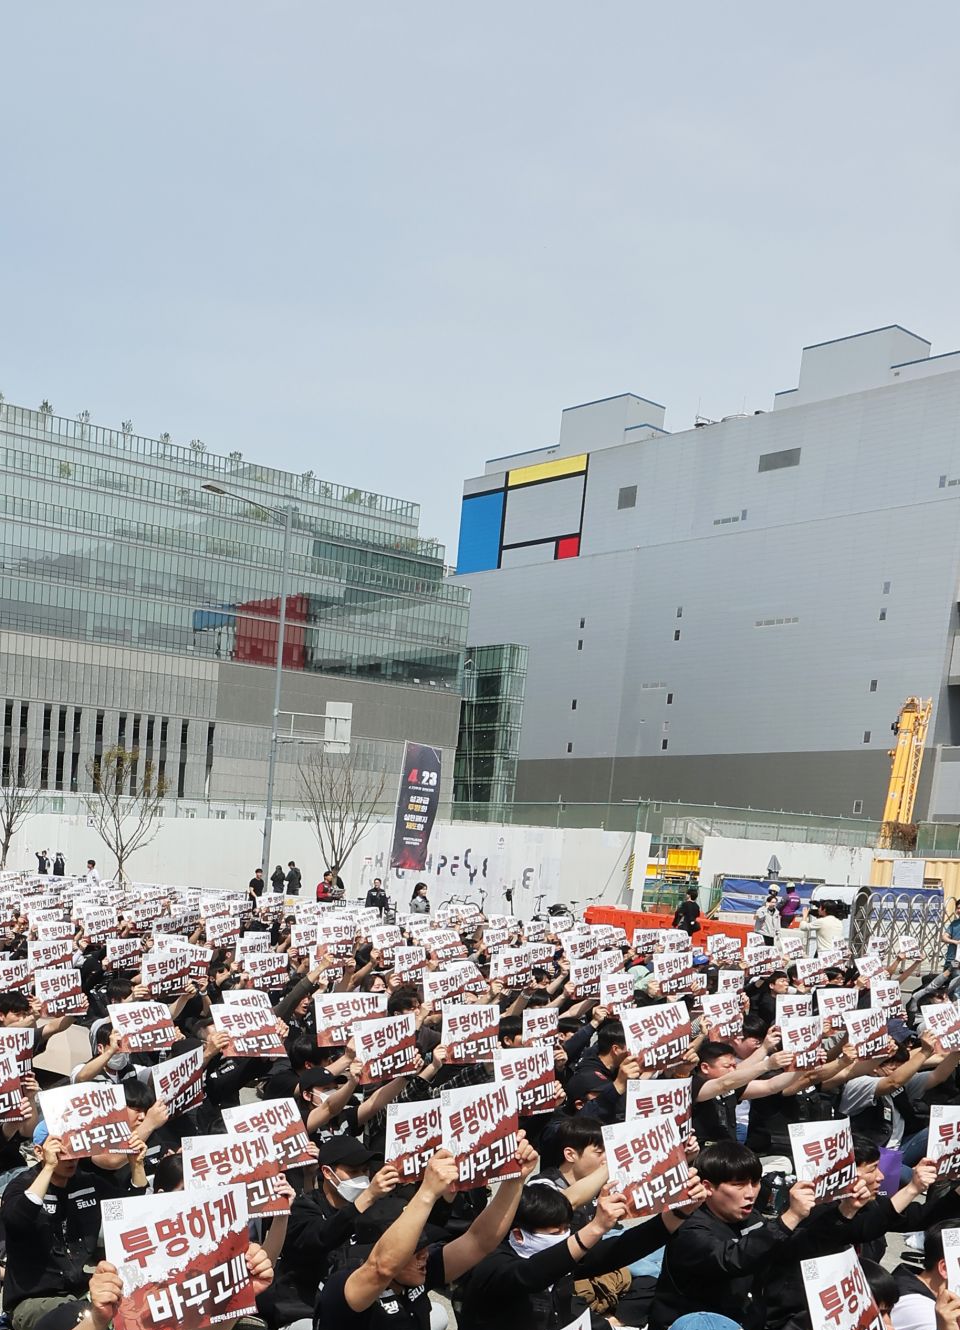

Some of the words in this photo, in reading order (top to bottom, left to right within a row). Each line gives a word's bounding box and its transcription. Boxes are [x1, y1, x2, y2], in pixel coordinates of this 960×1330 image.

[134, 905, 161, 918] 투명하게
[203, 902, 227, 914] 투명하게
[87, 918, 115, 930] 투명하게
[209, 920, 237, 934] 투명하게
[110, 940, 138, 956] 투명하게
[428, 933, 457, 944] 투명하게
[32, 942, 68, 959] 투명하게
[398, 948, 424, 966] 투명하게
[146, 955, 187, 976] 투명하게
[250, 956, 284, 971] 투명하게
[574, 964, 603, 981] 투명하게
[657, 955, 690, 975] 투명하게
[40, 972, 80, 994] 투명하게
[151, 975, 189, 995] 바꾸고!!!
[662, 974, 693, 993] 바꾸고!!!
[116, 1004, 166, 1027] 투명하게
[322, 996, 379, 1020] 투명하게
[220, 1010, 269, 1030] 투명하게
[447, 1007, 495, 1034] 투명하게
[629, 1005, 682, 1041] 투명하게
[852, 1013, 886, 1034] 투명하게
[128, 1028, 175, 1048] 바꾸고!!!
[234, 1034, 281, 1052] 바꾸고!!!
[361, 1017, 410, 1049] 투명하게
[453, 1038, 497, 1059] 바꾸고!!!
[644, 1035, 690, 1067] 바꾸고!!!
[858, 1037, 890, 1057] 바꾸고!!!
[370, 1046, 415, 1077] 바꾸고!!!
[159, 1054, 200, 1095] 투명하게
[448, 1086, 509, 1140] 투명하게
[70, 1121, 131, 1152] 바꾸고!!!
[613, 1116, 673, 1170] 투명하게
[190, 1136, 268, 1181] 투명하게
[459, 1132, 518, 1182] 바꾸고!!!
[631, 1161, 689, 1210] 바꾸고!!!
[77, 1200, 96, 1210] SELU
[120, 1190, 238, 1268] 투명하게
[146, 1252, 250, 1324] 바꾸고!!!
[408, 1284, 426, 1303] SELU
